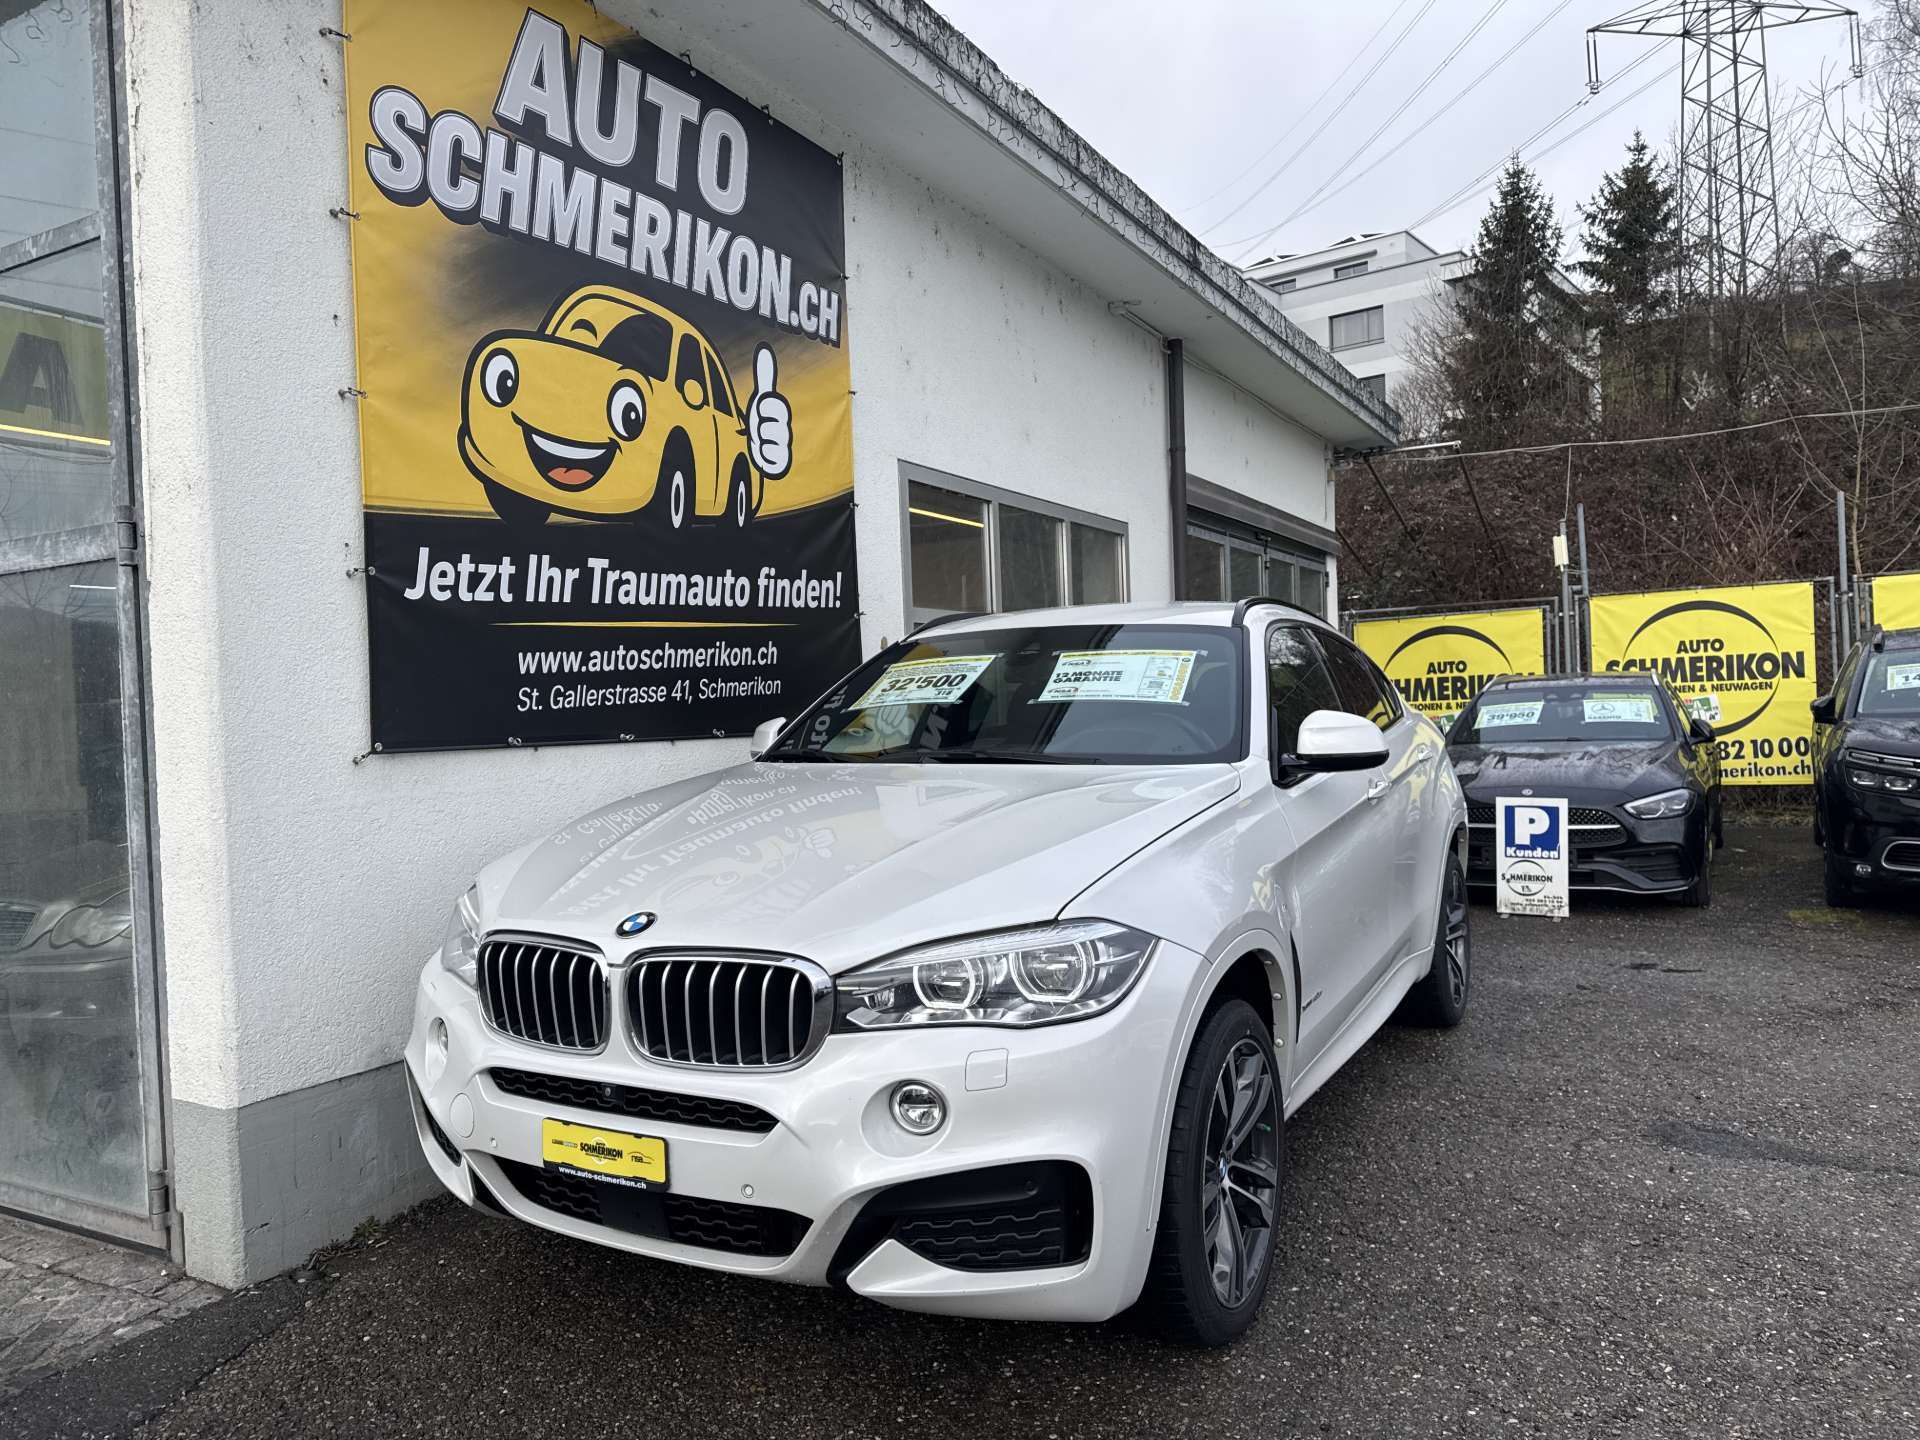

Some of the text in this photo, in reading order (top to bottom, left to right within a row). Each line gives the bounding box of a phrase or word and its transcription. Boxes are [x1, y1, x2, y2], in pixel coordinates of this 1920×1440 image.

[494, 9, 749, 215] AUTO
[367, 88, 841, 342] SCHMERIKON.CH
[403, 547, 843, 609] Jetzt Ihr Traumauto finden!
[1677, 638, 1725, 655] AUTO
[518, 641, 778, 674] www.autoschmerikon.ch
[1427, 660, 1468, 675] AUTO
[881, 673, 968, 693] 32'500
[1053, 676, 1122, 684] GARANTIE
[1699, 685, 1707, 693] &
[1711, 681, 1773, 692] NEUWAGEN
[517, 676, 782, 712] St. Gallerstrasse 41, Schmerikon
[1409, 702, 1443, 712] IONEN
[1716, 736, 1811, 761] 82 10 00
[1514, 806, 1550, 846] P
[1506, 846, 1559, 859] Kunden
[580, 1142, 624, 1159] SCHMERIKON
[558, 1166, 647, 1189] www.auto-schmerikon.ch
